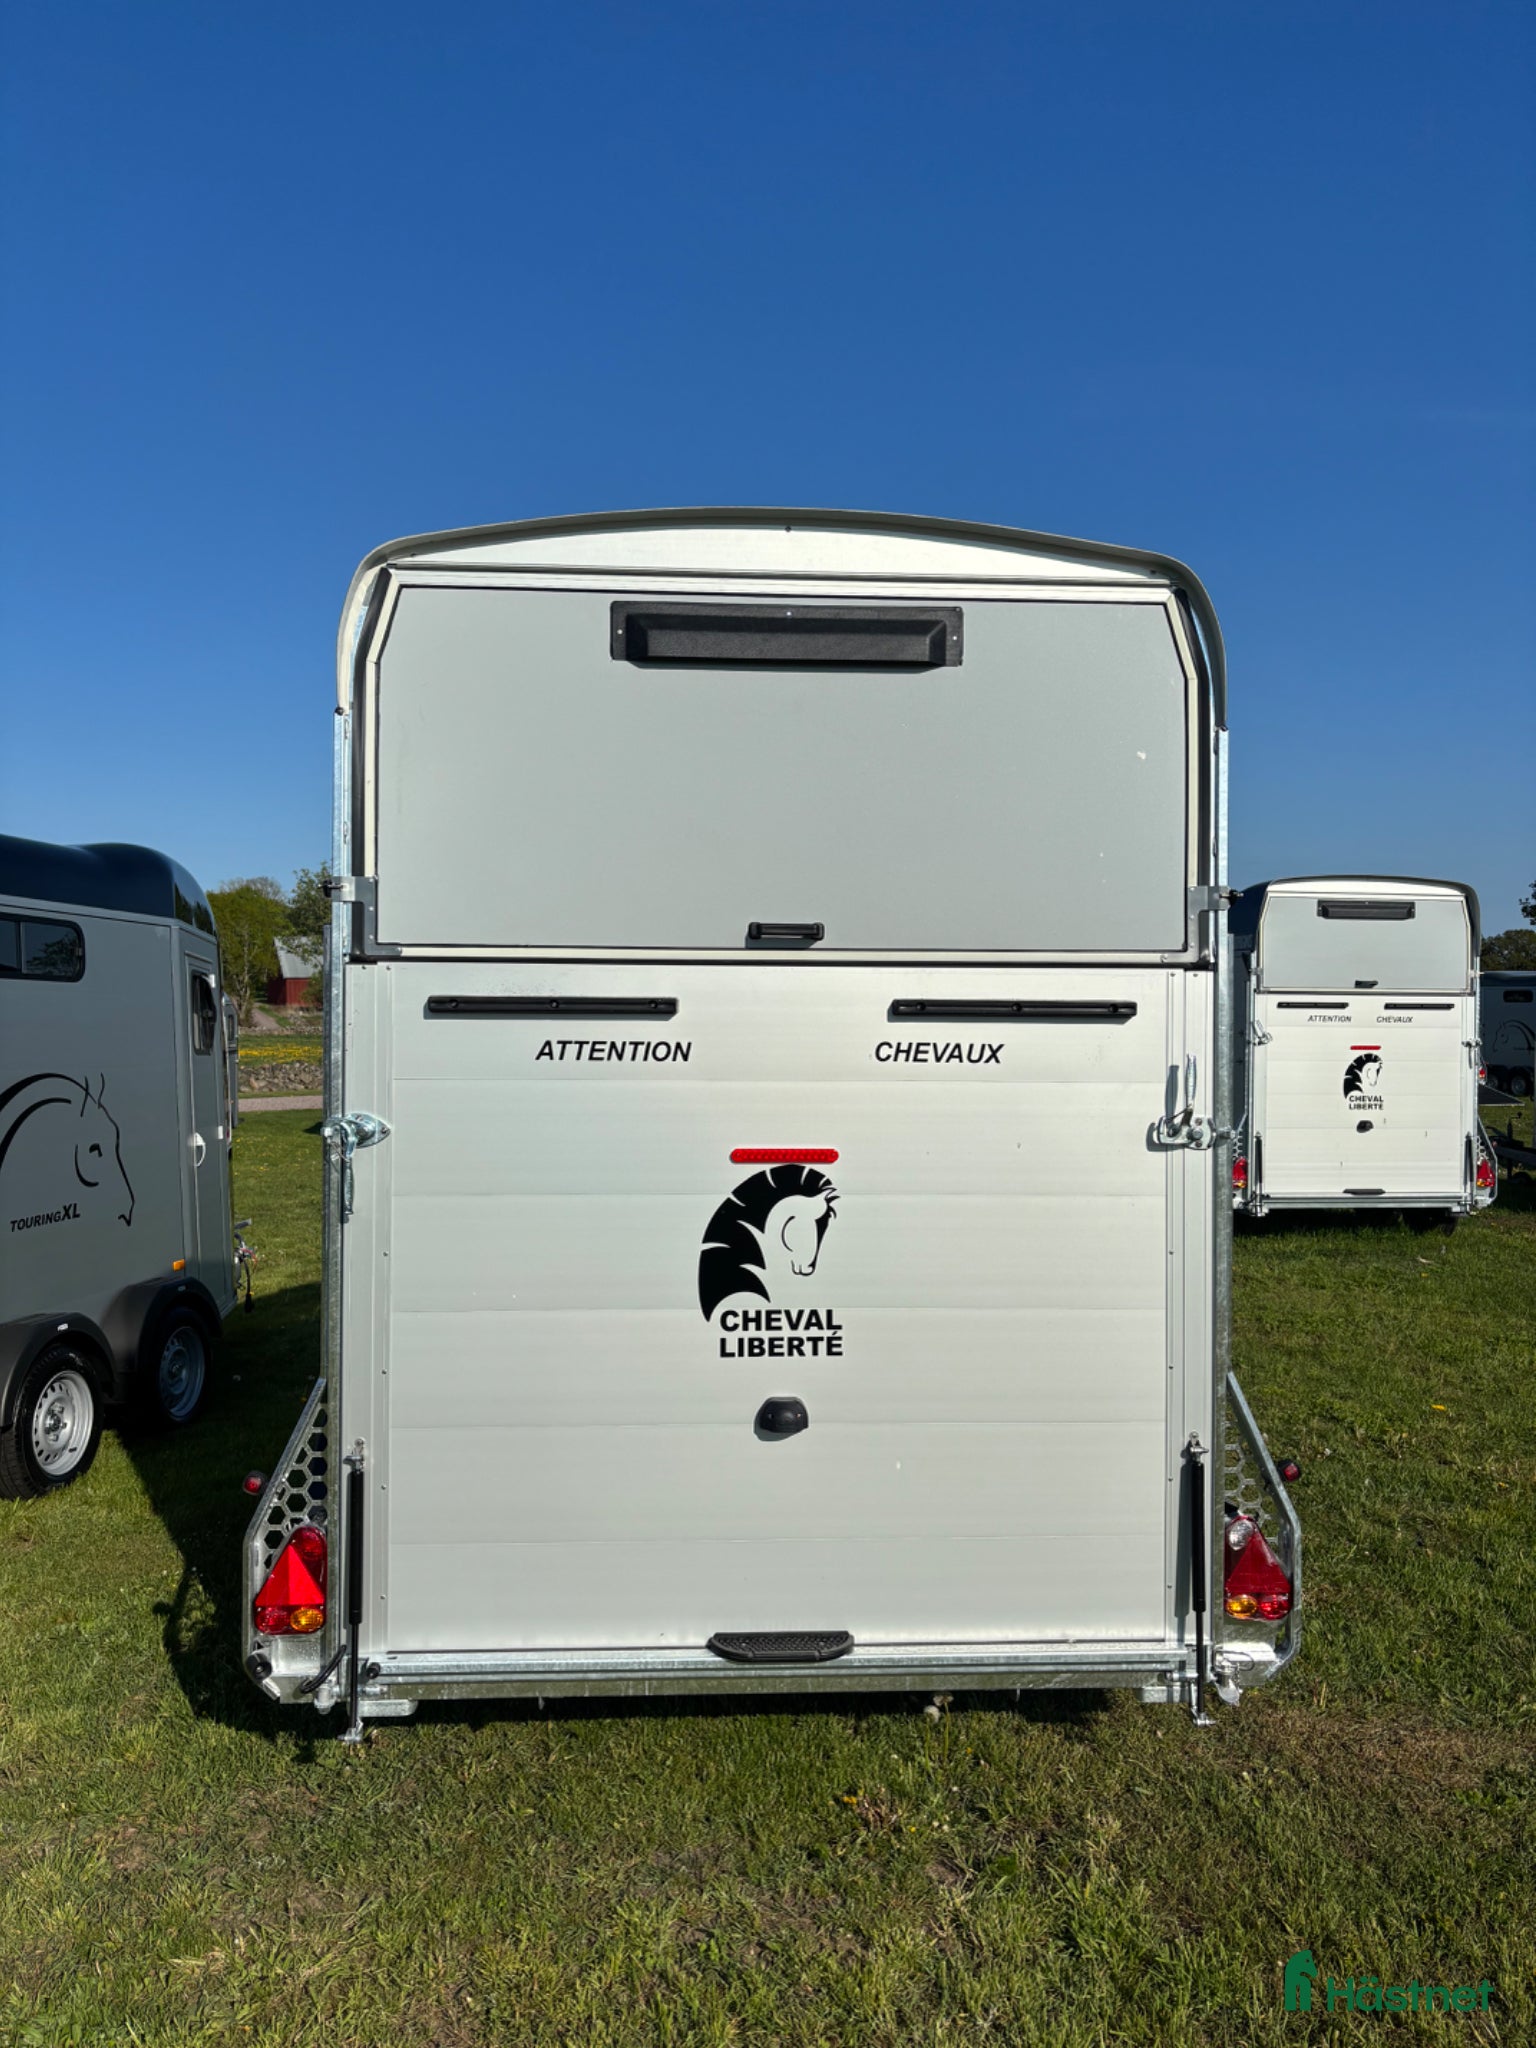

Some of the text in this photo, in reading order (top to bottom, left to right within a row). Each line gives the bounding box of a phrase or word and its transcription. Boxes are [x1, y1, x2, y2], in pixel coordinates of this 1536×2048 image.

[1307, 1014, 1352, 1023] ATTENTION
[1376, 1015, 1413, 1024] CHEVAUX
[536, 1039, 692, 1062] ATTENTION
[875, 1041, 1004, 1064] CHEVAUX
[719, 1308, 843, 1332] CHEVAL
[719, 1331, 844, 1358] LIBERTÉ
